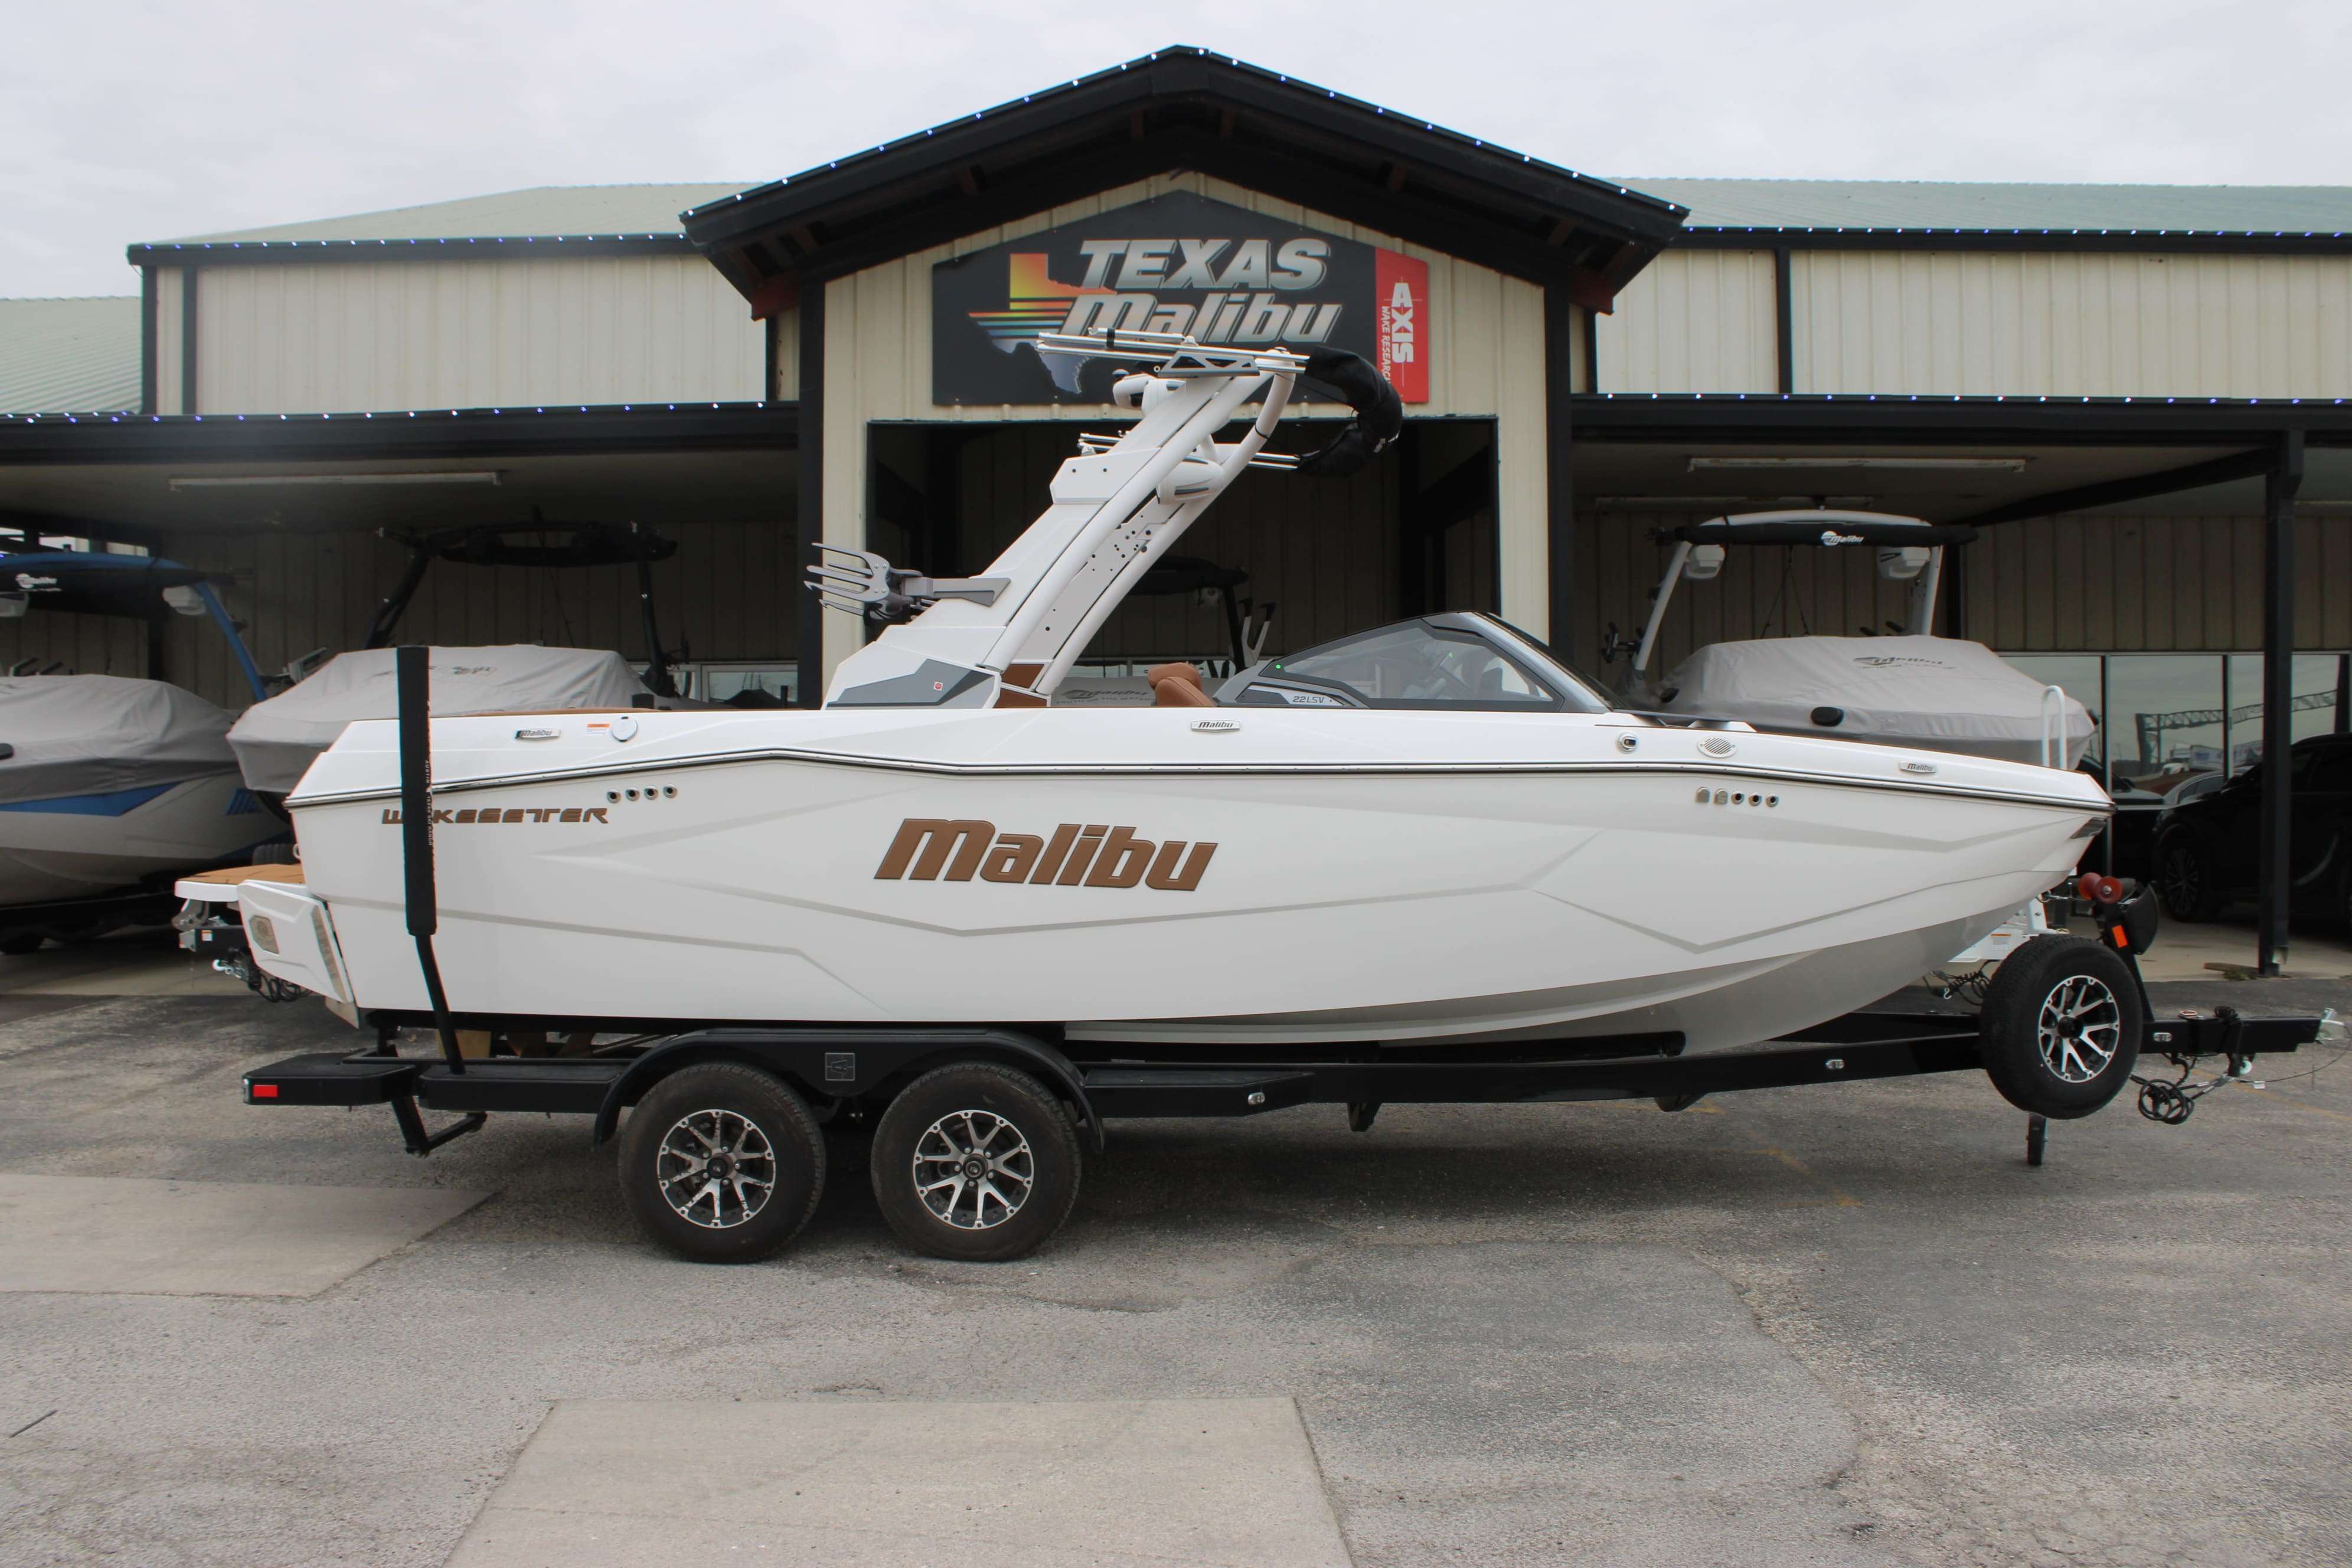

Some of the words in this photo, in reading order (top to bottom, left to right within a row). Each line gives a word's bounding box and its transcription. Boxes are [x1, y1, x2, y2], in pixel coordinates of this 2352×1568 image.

[1080, 239, 1331, 290] TEXAS
[1058, 293, 1342, 344] Malibu
[1381, 305, 1390, 334] WAKE
[1391, 282, 1414, 363] AXIS
[1293, 695, 1324, 704] 22LSV
[381, 808, 609, 824] WKESETTER
[874, 818, 1219, 891] Malibu
